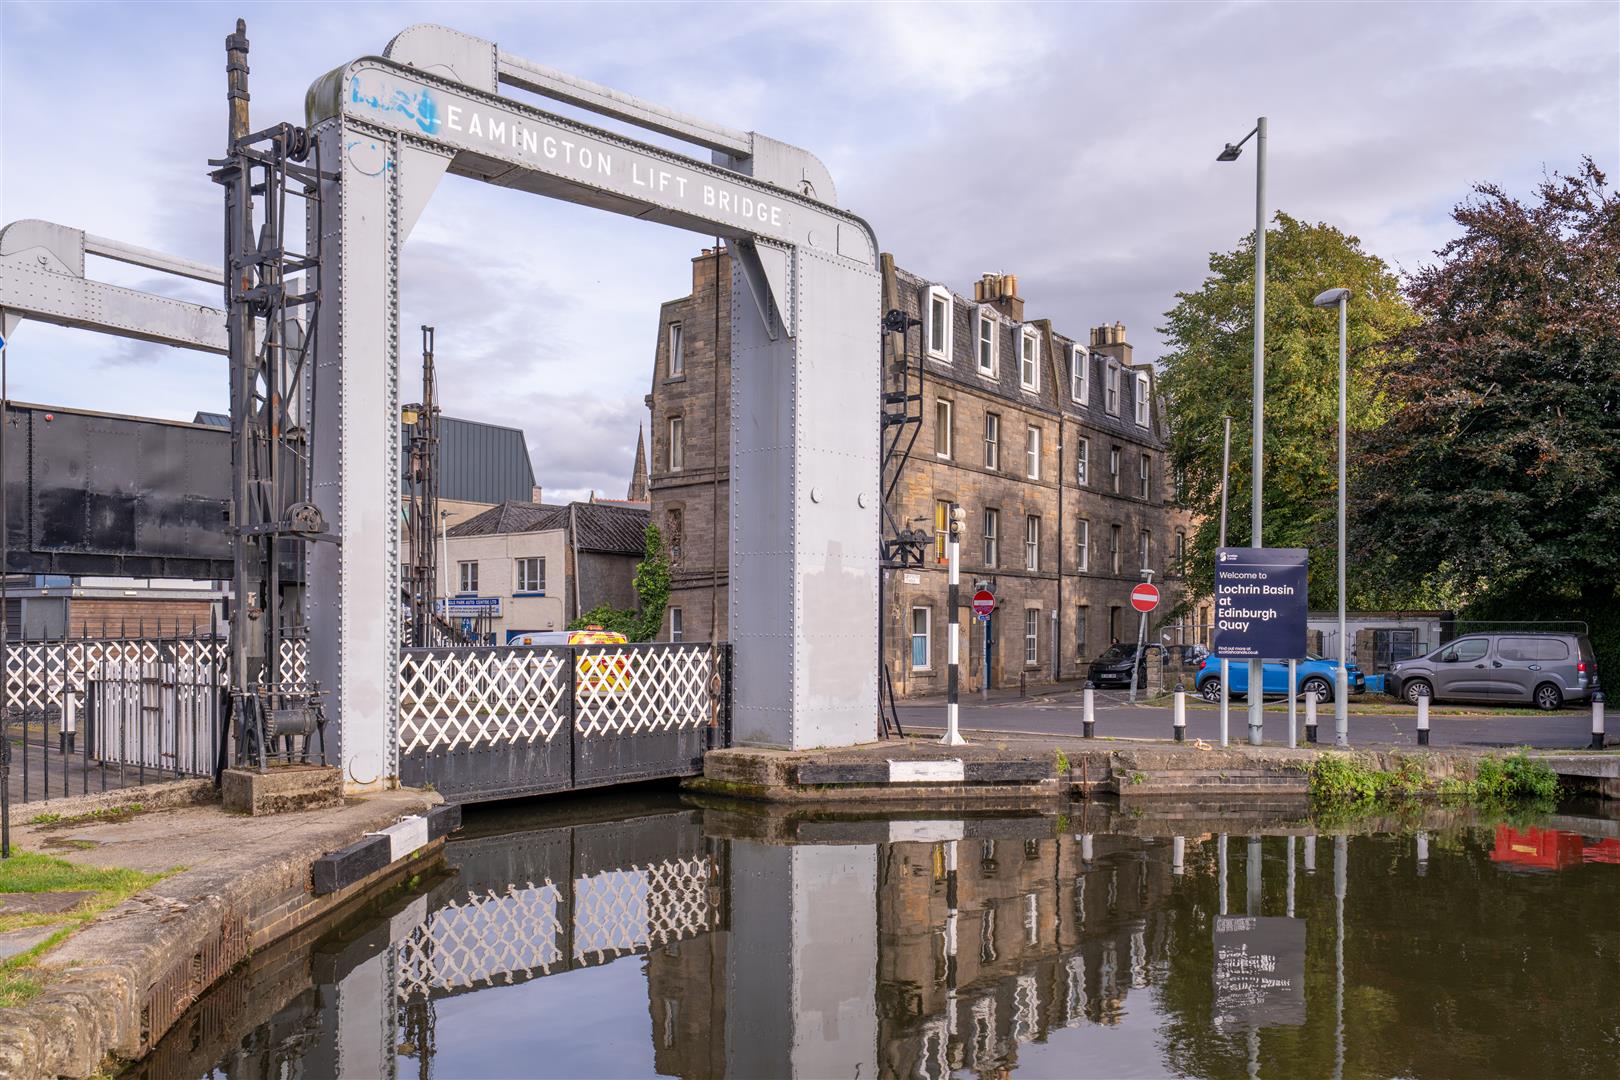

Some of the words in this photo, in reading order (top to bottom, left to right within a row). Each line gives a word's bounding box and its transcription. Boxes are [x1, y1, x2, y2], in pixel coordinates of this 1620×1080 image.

[632, 163, 687, 198] LIFT
[703, 185, 782, 227] BRIDGE
[1219, 571, 1257, 579] Welcome
[1218, 584, 1260, 594] Lochrin
[1263, 585, 1294, 595] Basin
[1219, 597, 1232, 605] at
[1218, 607, 1277, 621] Edinburgh
[1218, 620, 1250, 633] Quay
